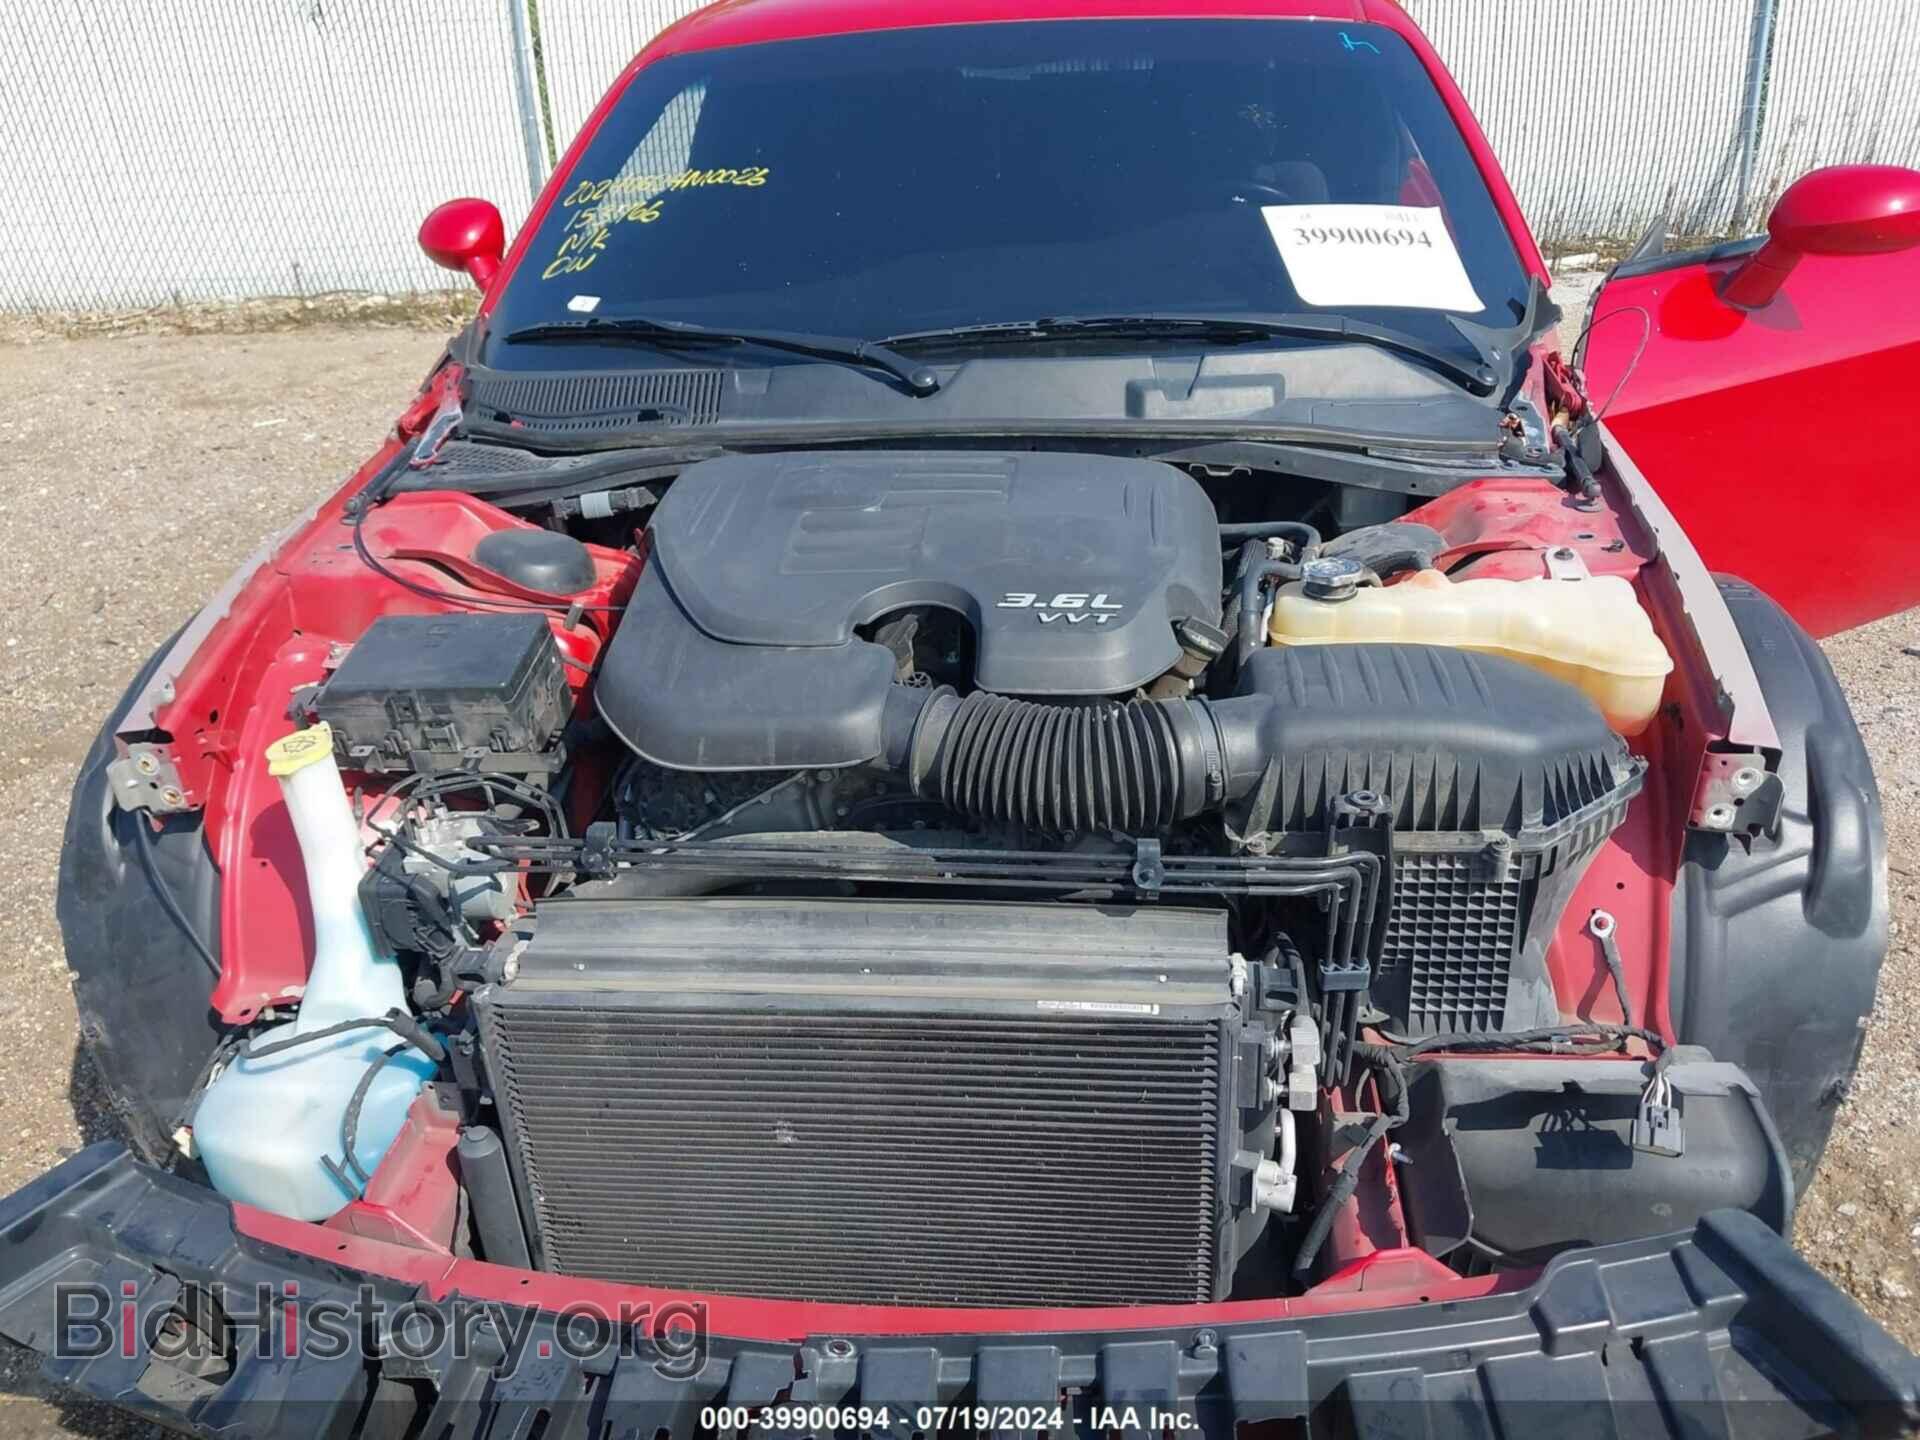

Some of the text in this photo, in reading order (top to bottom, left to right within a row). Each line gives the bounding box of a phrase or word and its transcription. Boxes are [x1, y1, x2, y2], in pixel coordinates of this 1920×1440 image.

[1294, 227, 1433, 248] 39900694
[997, 592, 1124, 609] 3.6L
[1037, 612, 1118, 624] VVT
